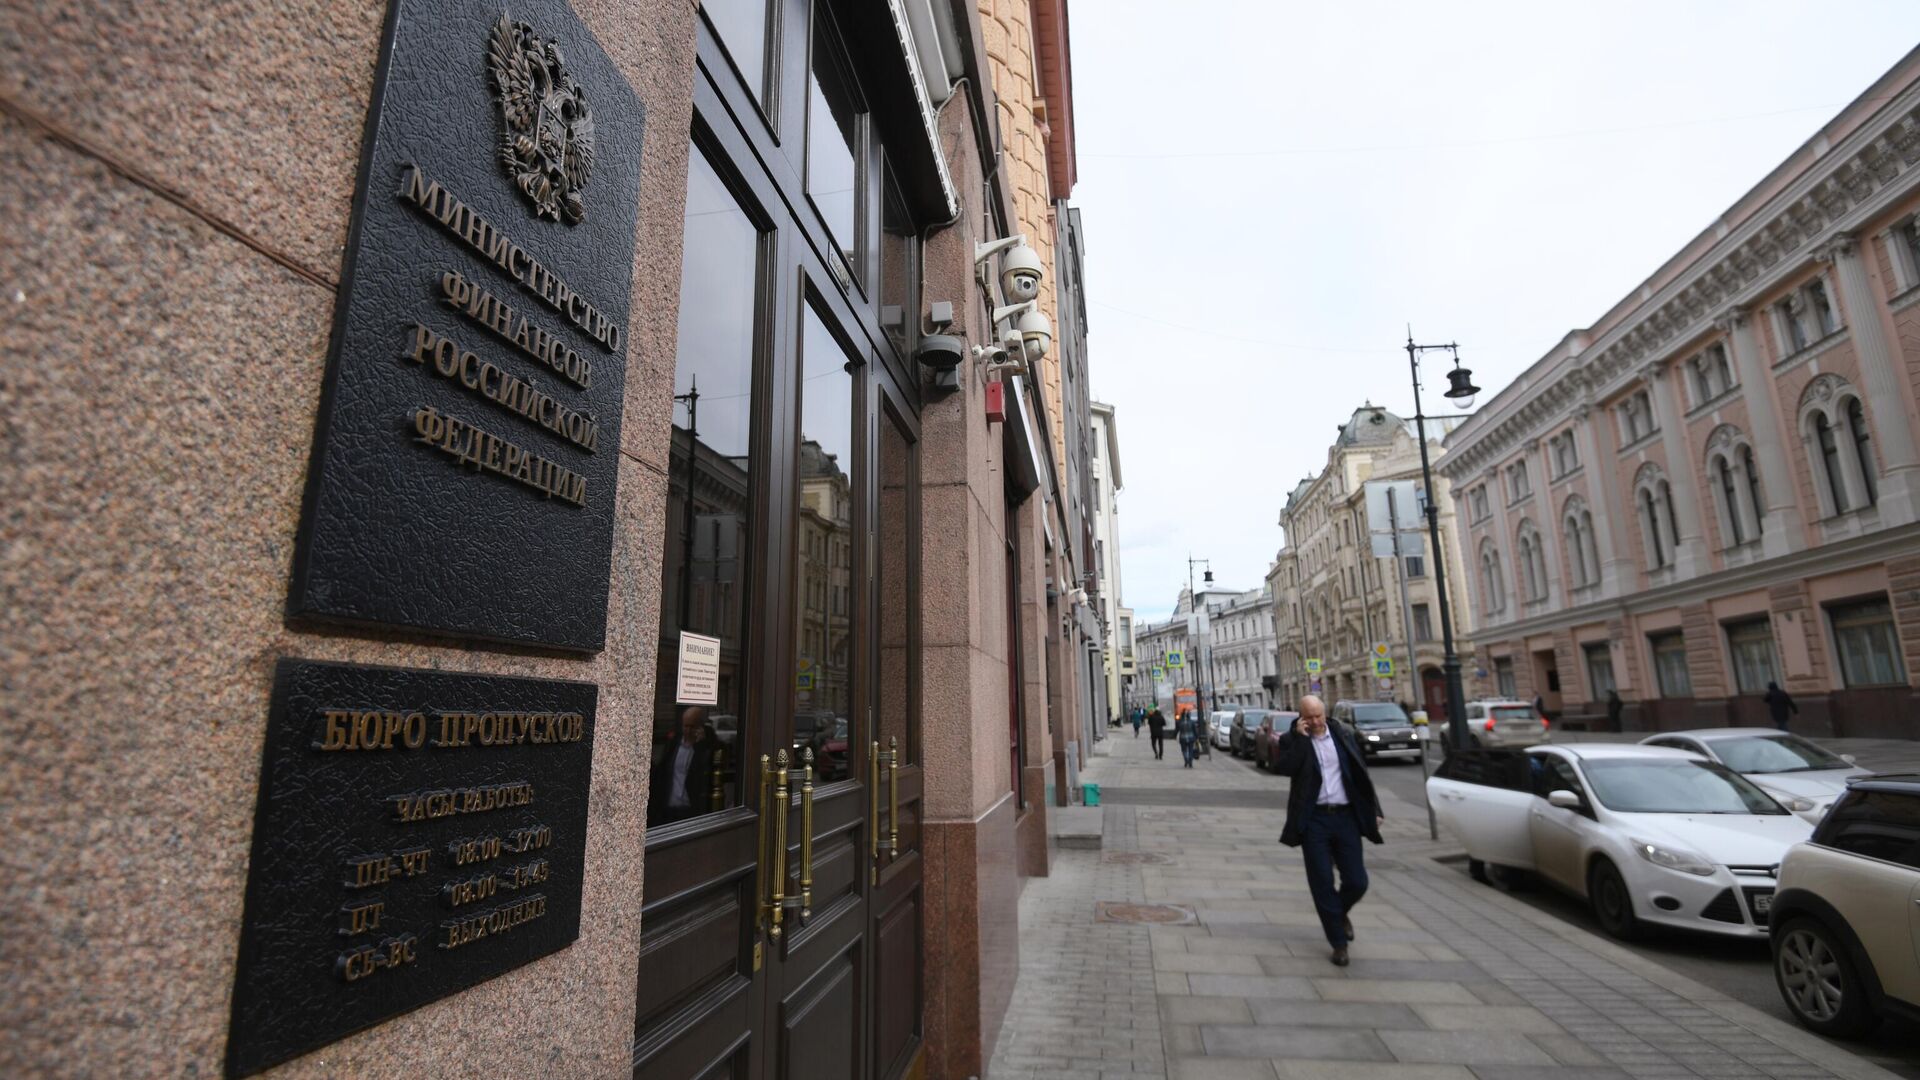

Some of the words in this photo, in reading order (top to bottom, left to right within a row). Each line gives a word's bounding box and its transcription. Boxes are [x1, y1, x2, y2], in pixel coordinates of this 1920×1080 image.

[407, 165, 621, 352] МИНИСТЕРСТВО
[441, 269, 593, 389] ФИНАНСОВ
[410, 321, 599, 452] РОССИЙСКОЙ
[414, 405, 588, 506] ФЕДЕРАЦИИ
[320, 710, 427, 750] БЮРО
[436, 710, 585, 748] ПРОПУСКОВ
[395, 792, 457, 822] ЧАСЫ
[462, 783, 534, 813] РАБОТЫ:
[354, 849, 432, 888] ПН-ЧТ
[344, 936, 419, 982] СБ-ВС
[446, 895, 548, 949] ВЫХОДНЫЕ
[351, 902, 386, 935] ПТ
